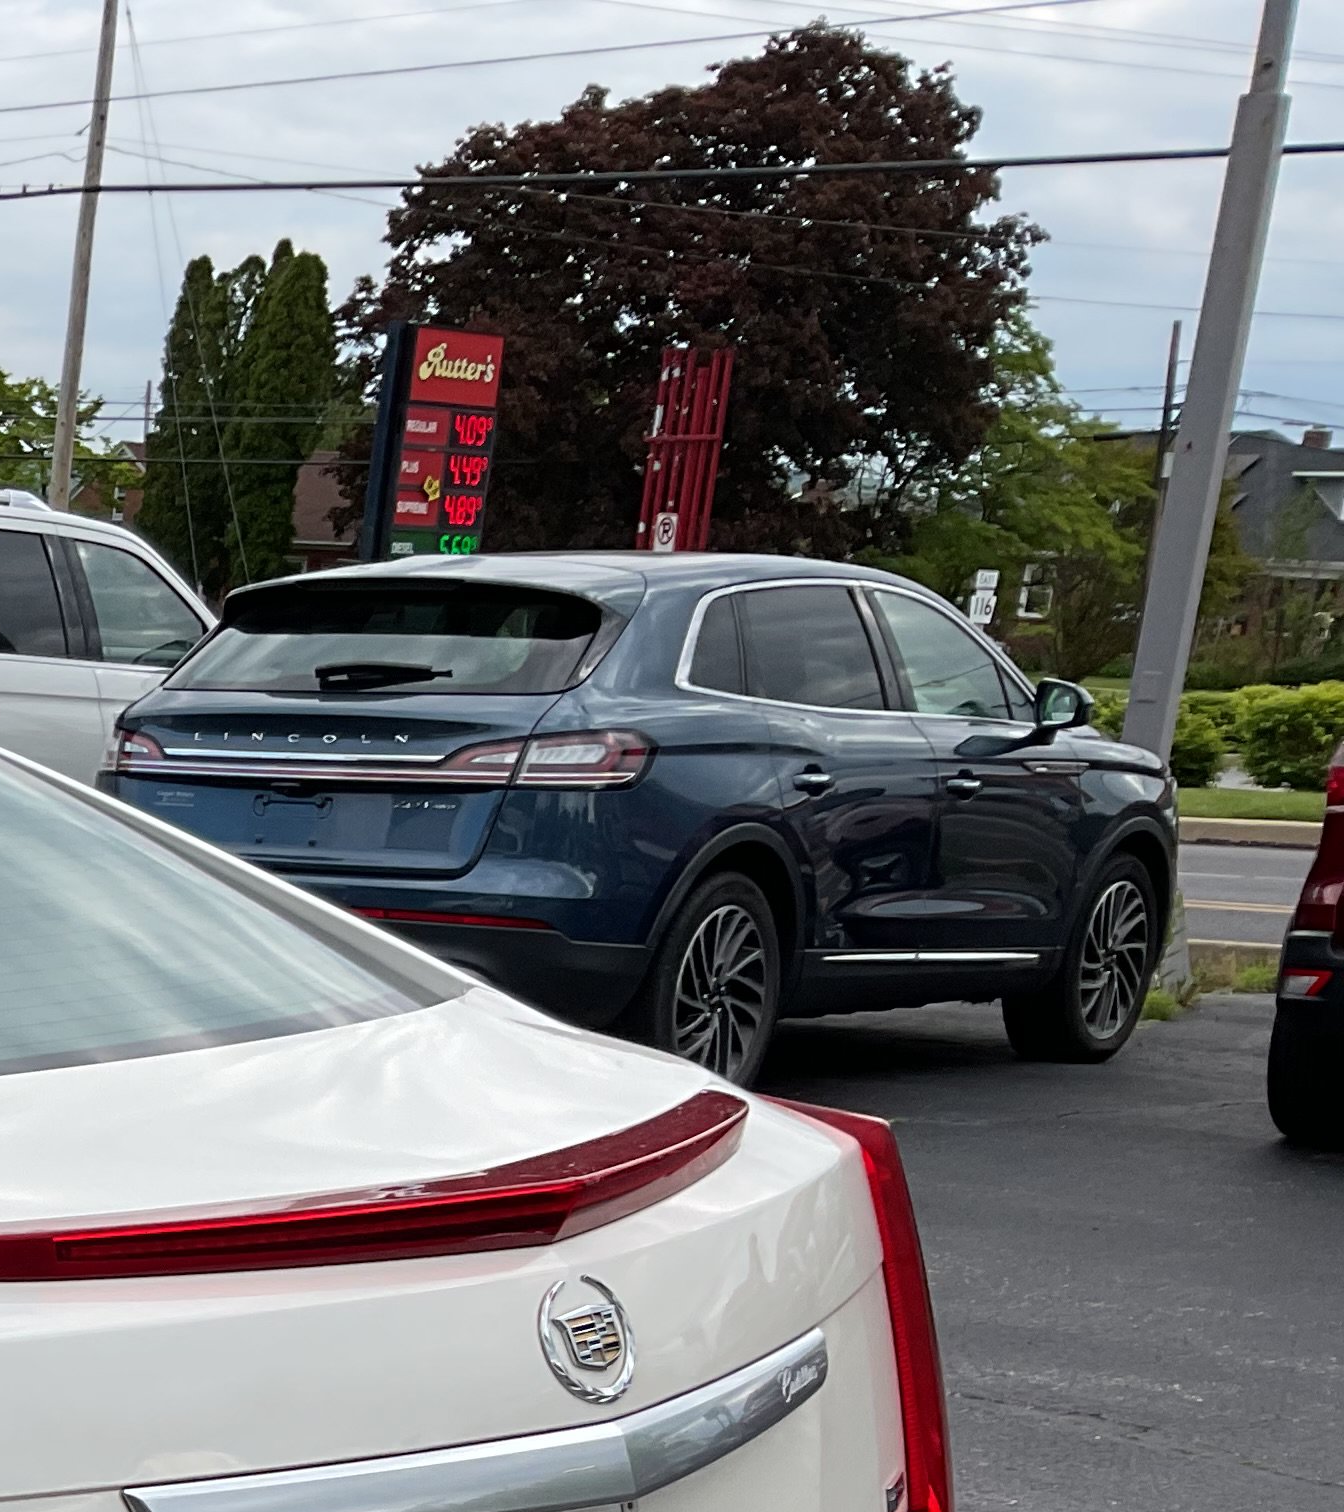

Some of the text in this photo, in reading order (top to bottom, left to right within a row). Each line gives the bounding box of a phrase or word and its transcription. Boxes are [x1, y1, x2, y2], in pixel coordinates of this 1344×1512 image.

[419, 343, 495, 383] Rutter's
[973, 597, 992, 616] 116
[193, 732, 410, 744] LINCOLN
